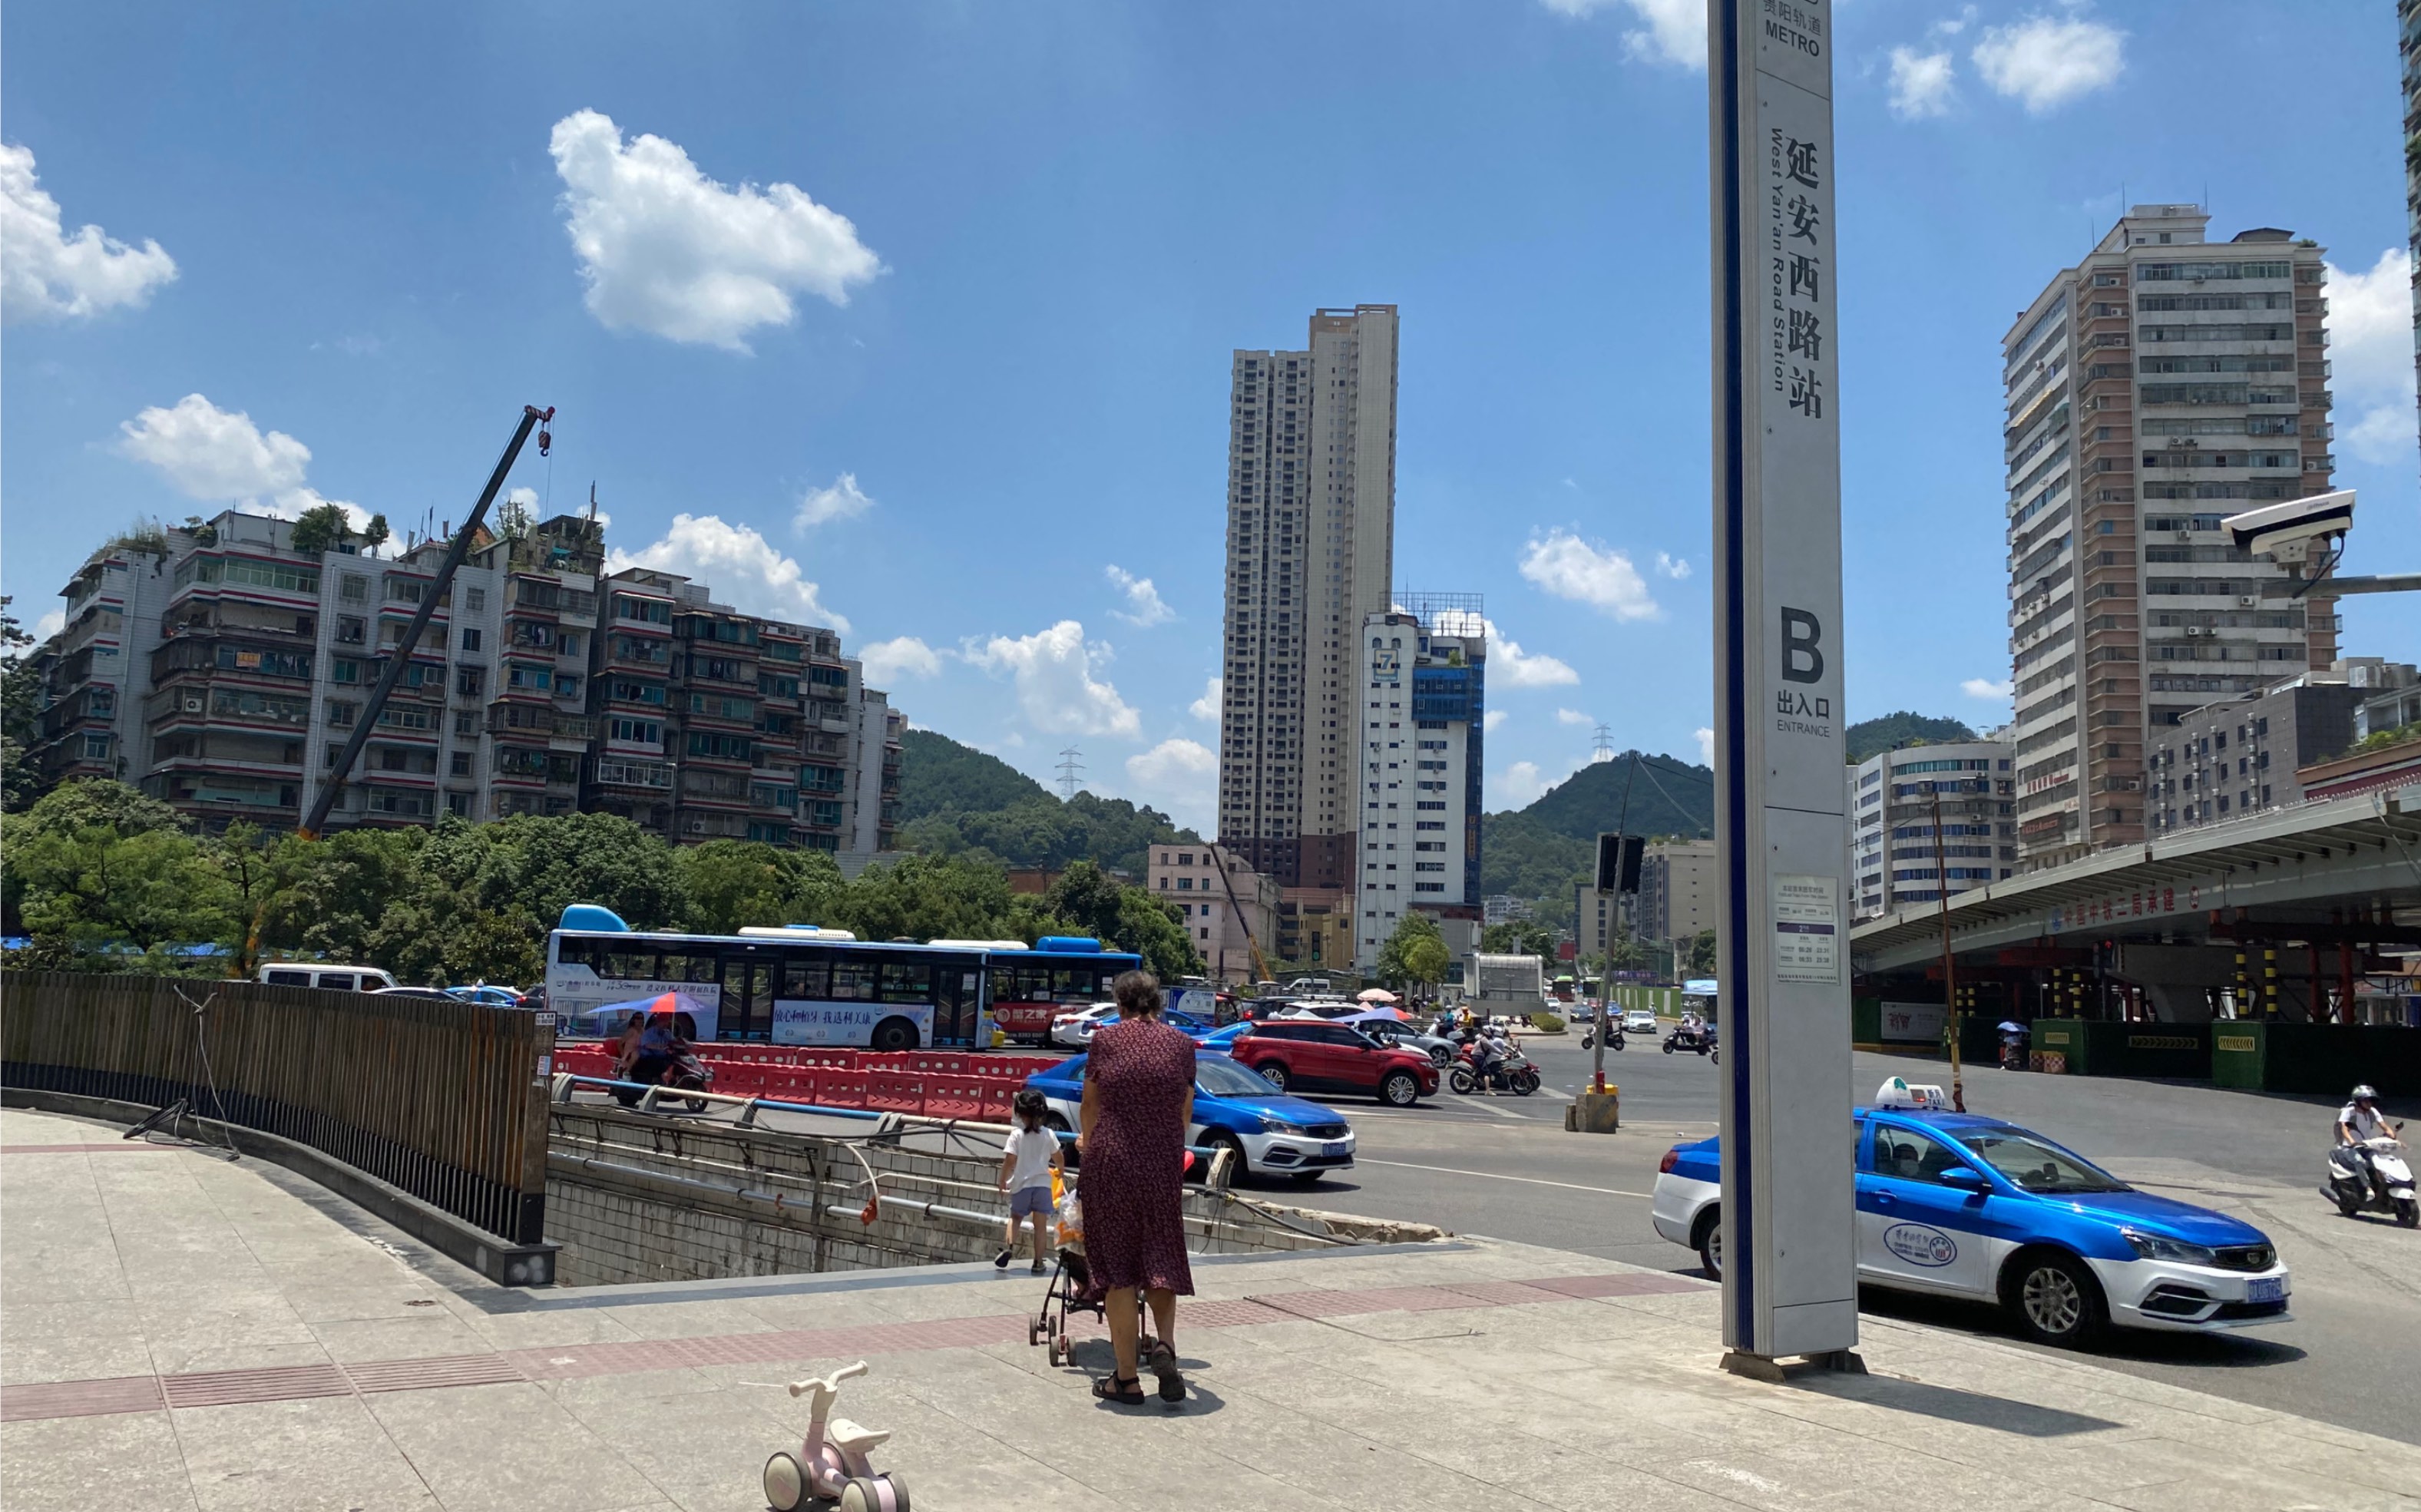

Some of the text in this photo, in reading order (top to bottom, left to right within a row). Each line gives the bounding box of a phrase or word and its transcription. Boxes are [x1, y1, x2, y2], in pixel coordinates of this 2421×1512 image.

[1766, 19, 1820, 57] METRO
[1771, 127, 1786, 392] West Yan'an Road Station
[1785, 137, 1823, 419] 延安西路站
[1380, 654, 1393, 670] 7
[1781, 606, 1824, 684] B
[1777, 690, 1830, 720] 出入口
[1777, 720, 1831, 737] ENTRANCE
[2063, 886, 2175, 928] 中国中铁二局承建
